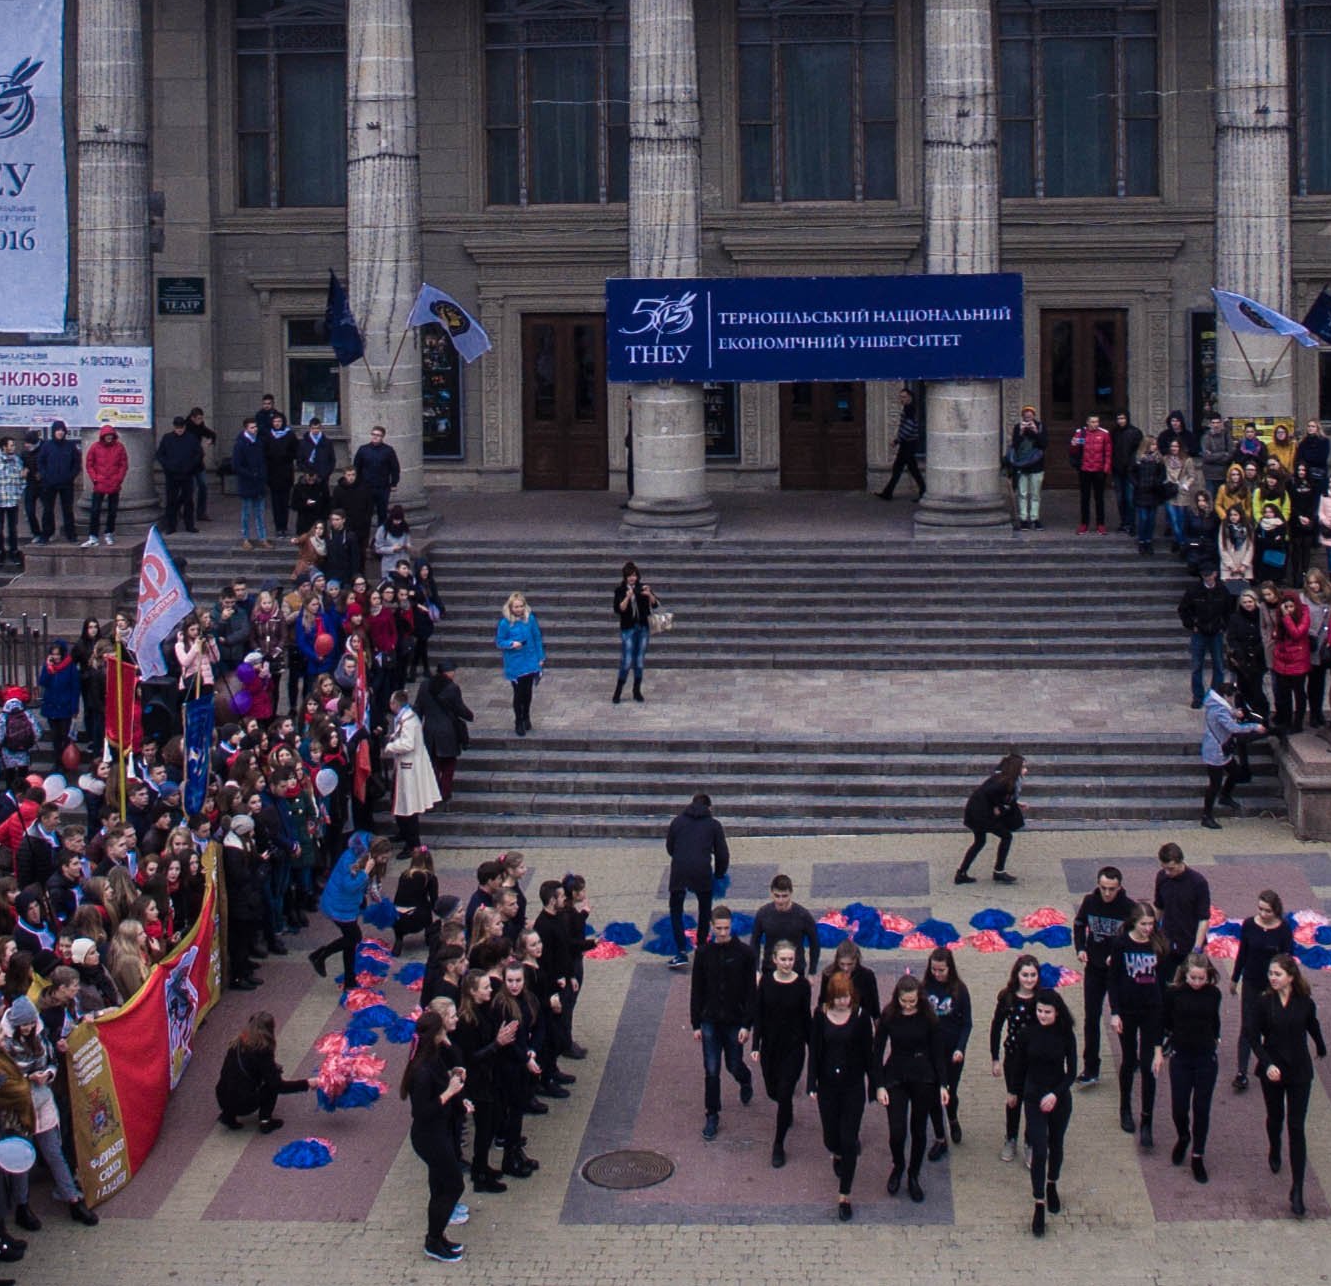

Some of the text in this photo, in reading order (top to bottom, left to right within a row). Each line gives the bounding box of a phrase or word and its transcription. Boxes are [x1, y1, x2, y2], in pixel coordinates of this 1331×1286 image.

[718, 307, 1011, 324] ТЕРНОПІЛЬСЬКИЙ НАЦІОНАЛЬНИЙ
[718, 334, 962, 350] ЕКОНОМІЧНИЙ УНІВЕРСИТЕТ
[625, 345, 692, 364] ТНЕУ
[7, 395, 80, 407] ШЕВЧЕНКА
